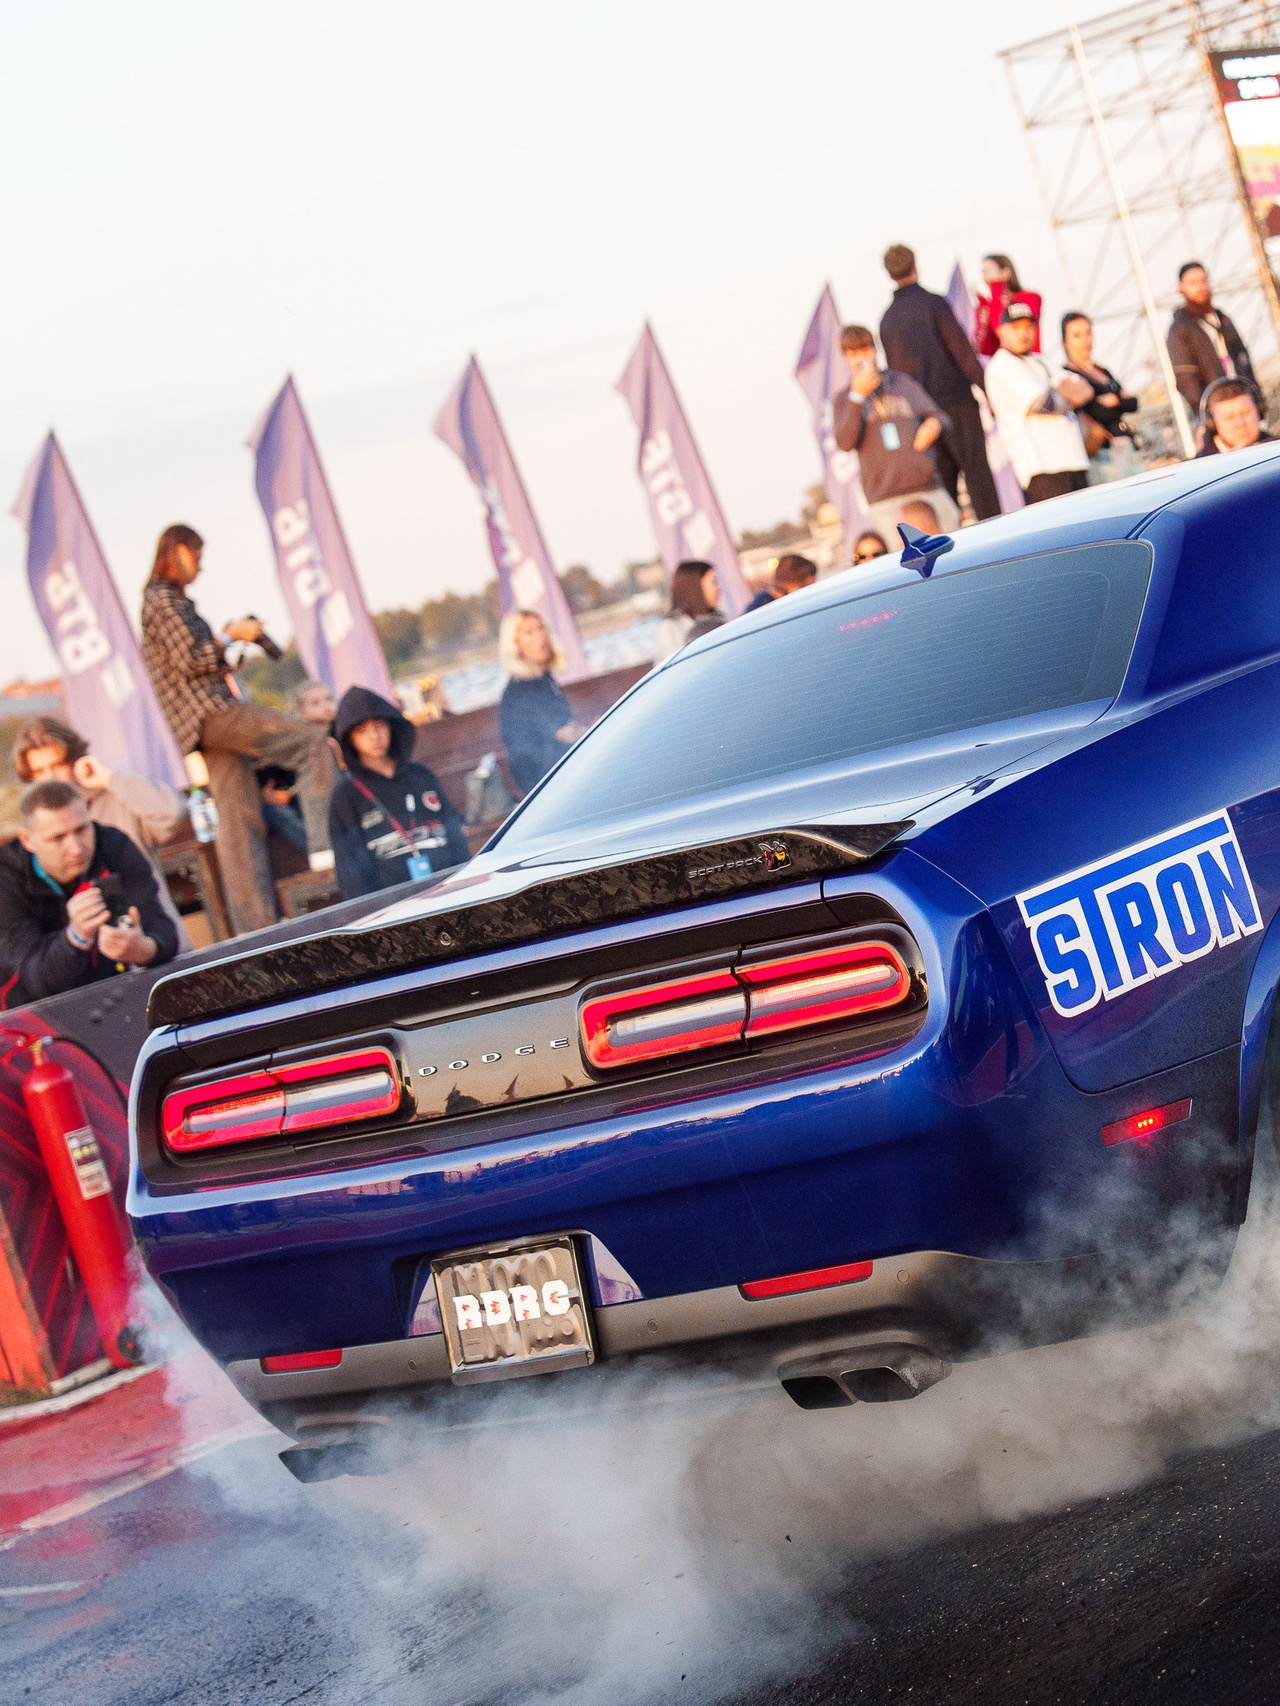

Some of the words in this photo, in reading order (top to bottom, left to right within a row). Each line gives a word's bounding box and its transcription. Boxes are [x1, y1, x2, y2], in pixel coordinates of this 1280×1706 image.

[688, 864, 725, 879] SCAT
[726, 855, 763, 869] PACK
[1022, 815, 1259, 1010] STRON
[418, 1037, 570, 1078] DODGE
[452, 1279, 571, 1331] RDRC
